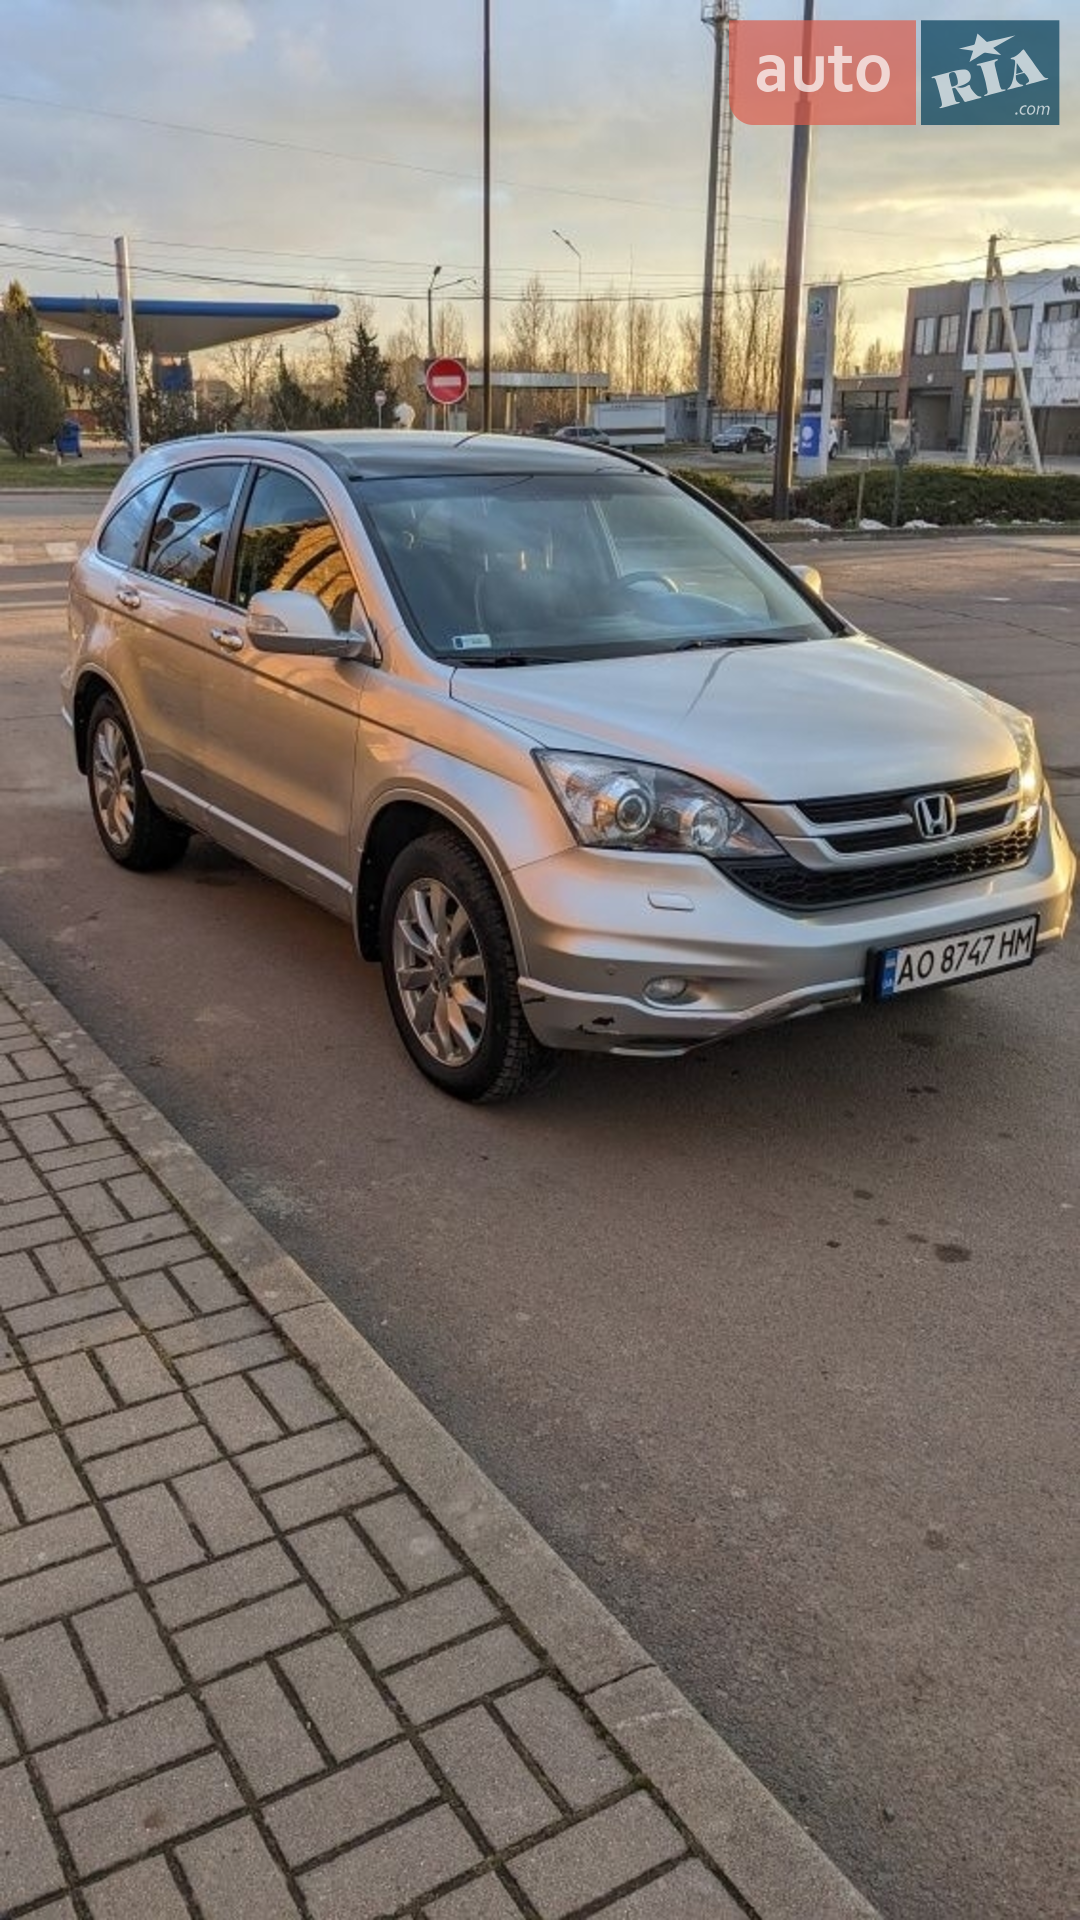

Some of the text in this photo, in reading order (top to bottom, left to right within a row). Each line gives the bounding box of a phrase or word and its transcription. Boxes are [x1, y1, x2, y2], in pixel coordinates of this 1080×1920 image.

[897, 925, 1033, 985] AO 8747 HM
